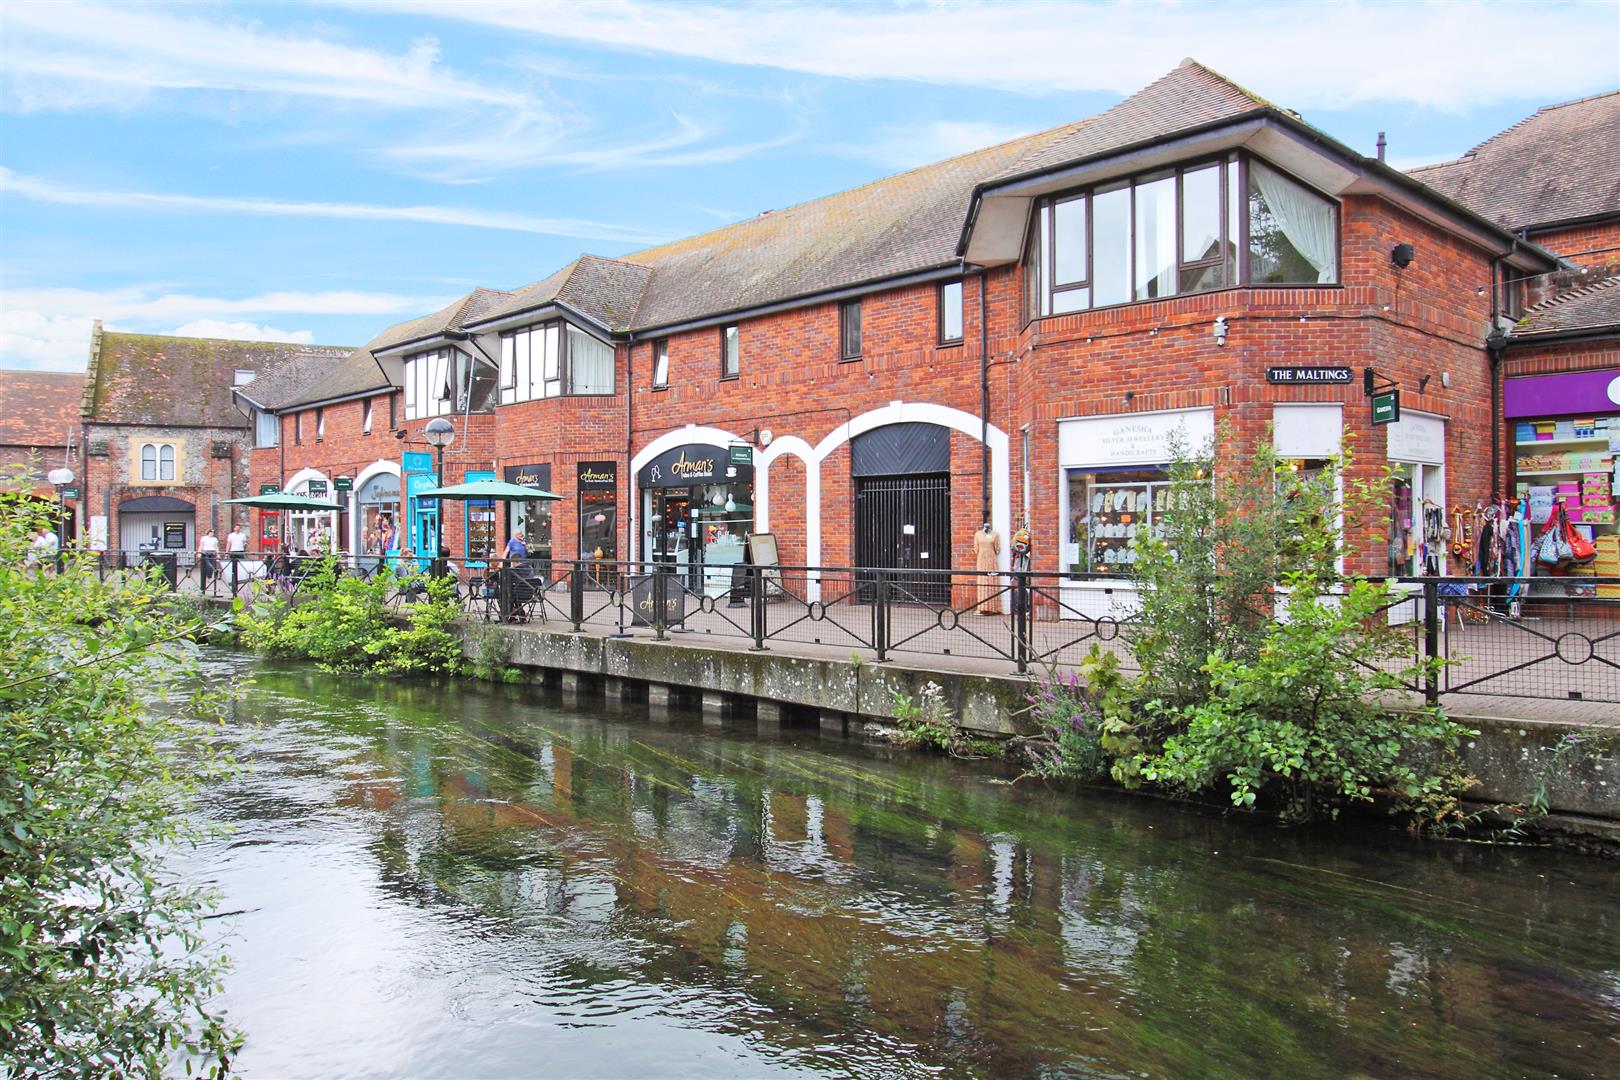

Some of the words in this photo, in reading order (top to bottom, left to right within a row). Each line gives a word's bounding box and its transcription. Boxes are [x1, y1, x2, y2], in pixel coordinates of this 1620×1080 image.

[1272, 369, 1292, 380] THE
[1296, 369, 1348, 380] MALTINGS
[1113, 425, 1152, 436] GANESHA
[671, 449, 713, 479] Arman's
[580, 467, 614, 481] Arman's
